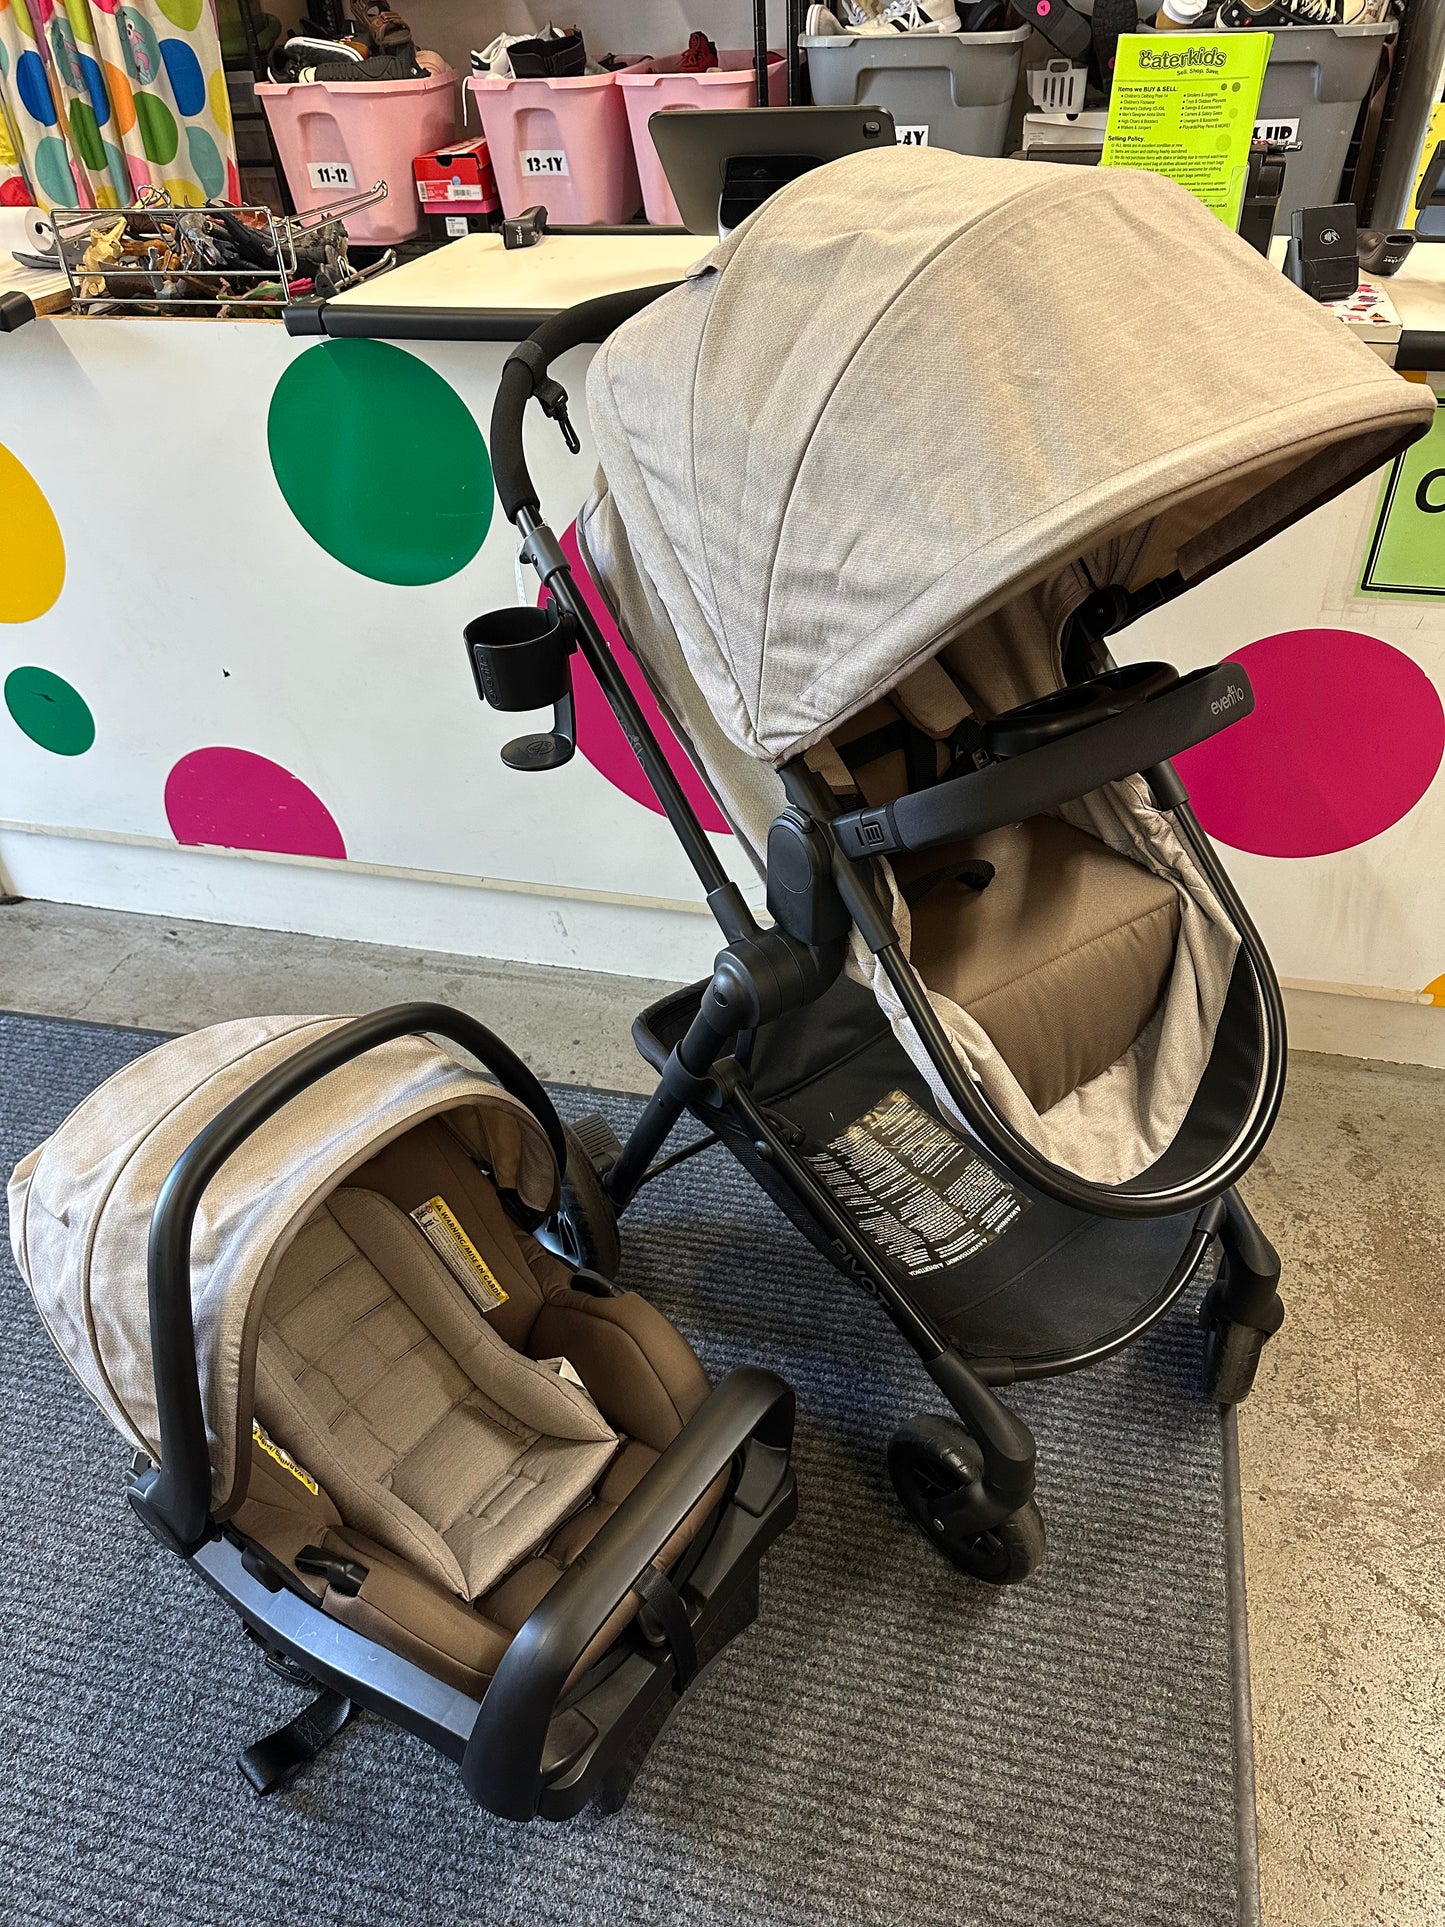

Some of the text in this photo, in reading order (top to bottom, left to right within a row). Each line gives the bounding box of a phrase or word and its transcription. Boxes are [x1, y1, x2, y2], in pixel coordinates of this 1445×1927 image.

[896, 131, 925, 145] -4Y
[317, 168, 349, 182] 11-12
[526, 157, 563, 171] 13-1Y
[1210, 684, 1244, 715] evenflo
[994, 1210, 1018, 1233] WARNING
[441, 1211, 502, 1297] WARNING/MISE EN GARDE
[831, 1238, 891, 1307] PIVOT
